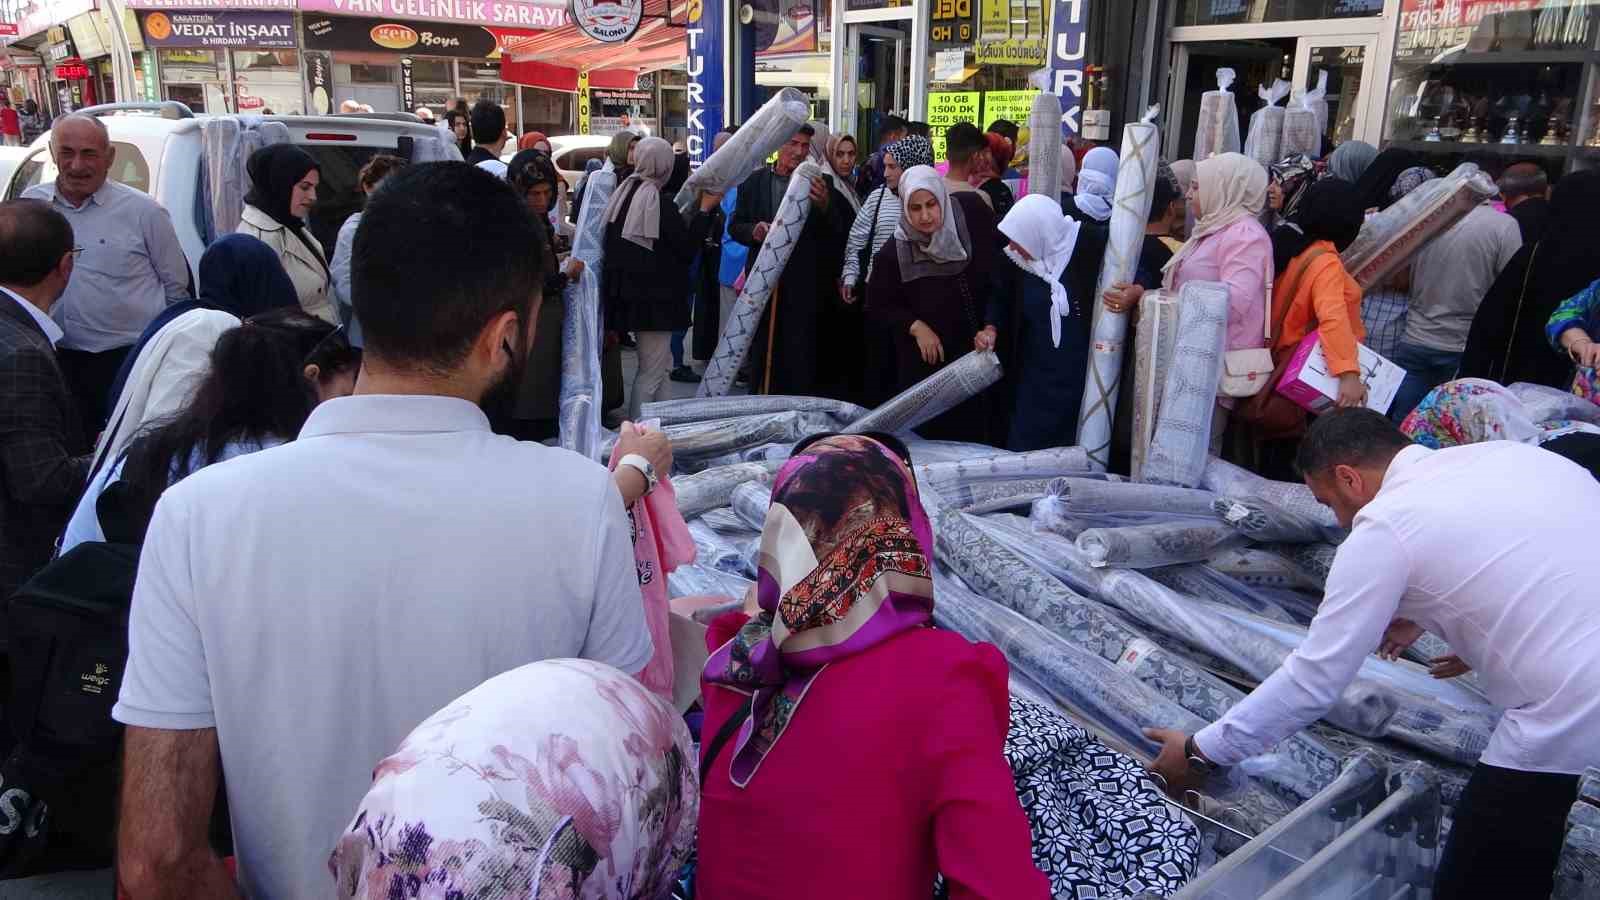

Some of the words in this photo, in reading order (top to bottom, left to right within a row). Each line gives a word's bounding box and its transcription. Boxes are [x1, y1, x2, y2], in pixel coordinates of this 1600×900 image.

[172, 24, 226, 36] VEDAT
[230, 22, 291, 40] İNŞAAT
[592, 26, 627, 38] SALONU
[953, 95, 969, 103] GB
[933, 105, 956, 113] 1500
[959, 105, 975, 113] DK
[931, 115, 949, 123] 250
[952, 115, 975, 124] SMS
